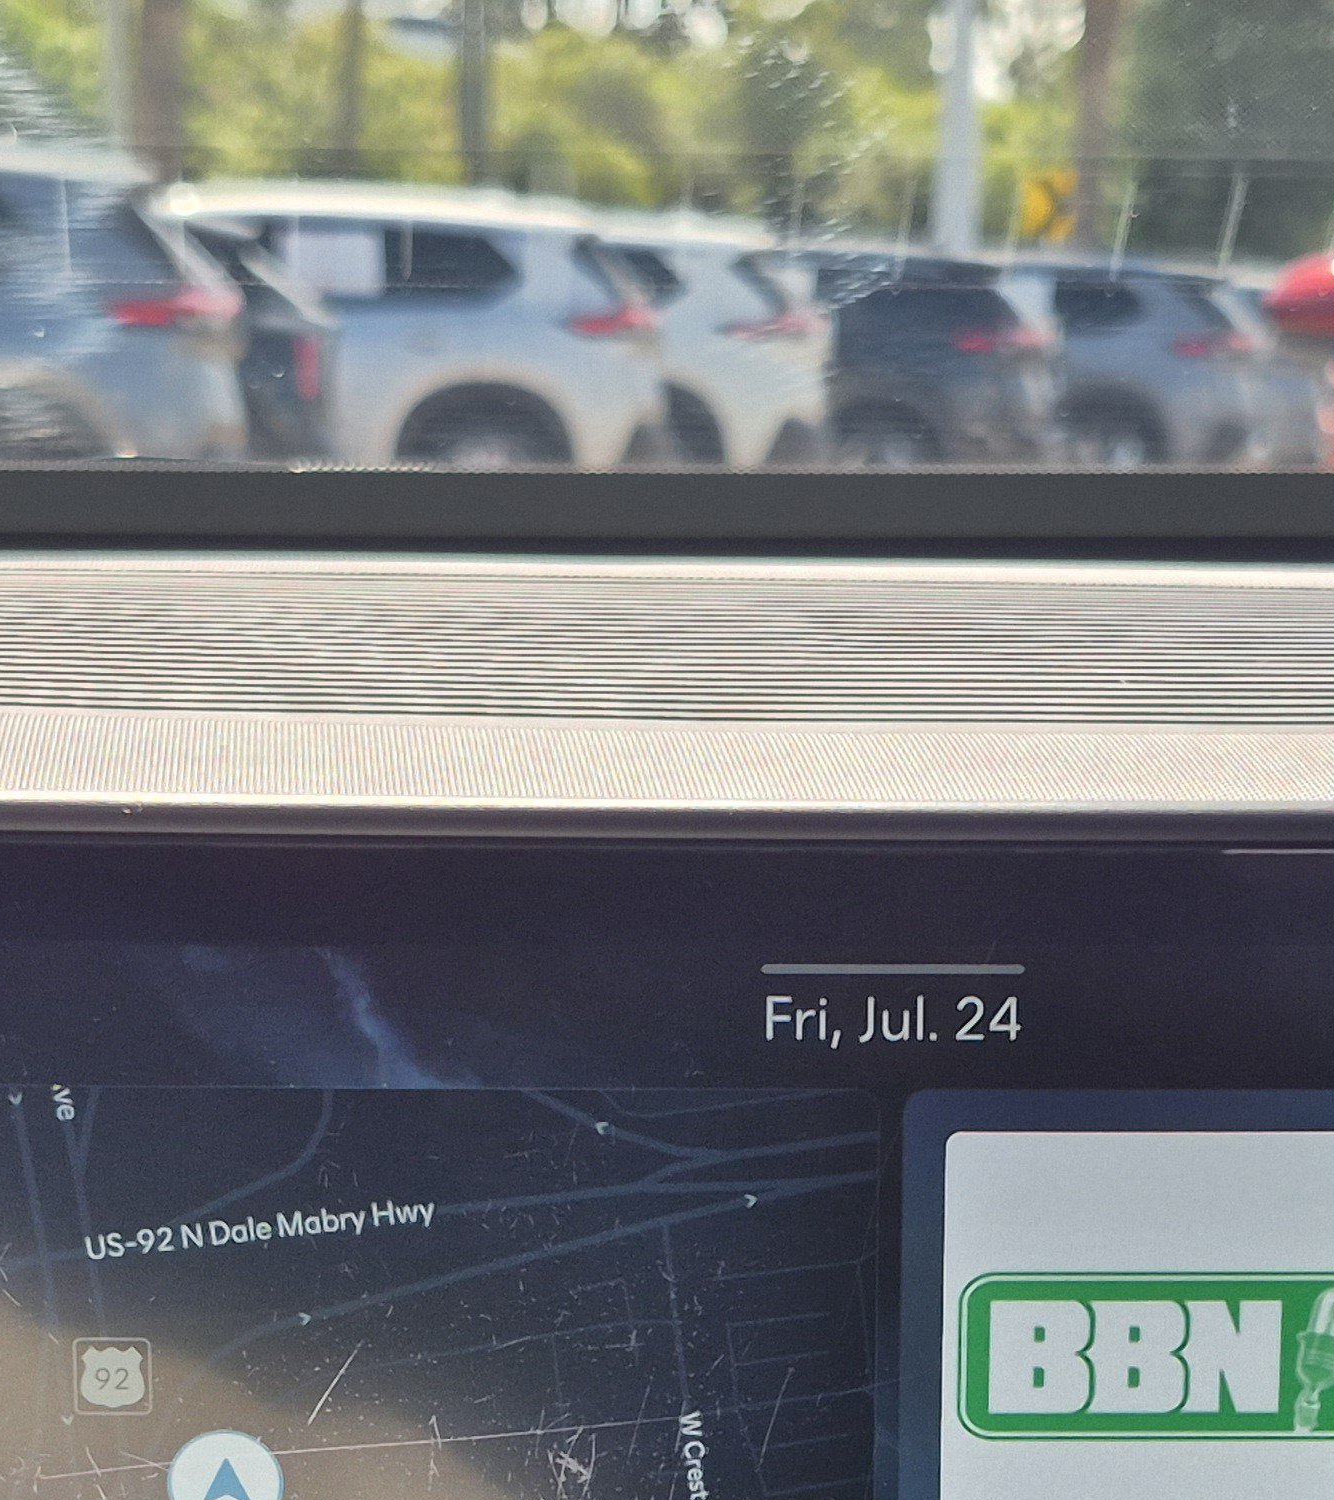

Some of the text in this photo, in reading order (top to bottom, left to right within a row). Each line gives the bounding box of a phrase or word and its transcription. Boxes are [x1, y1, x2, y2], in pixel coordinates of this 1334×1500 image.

[763, 995, 1021, 1049] Fri, Jul. 24
[52, 1084, 75, 1121] ve
[85, 1200, 435, 1260] US-92 N Dale Mabry Hwy
[94, 1366, 130, 1391] 92
[988, 1300, 1283, 1414] BBN
[679, 1410, 703, 1437] W
